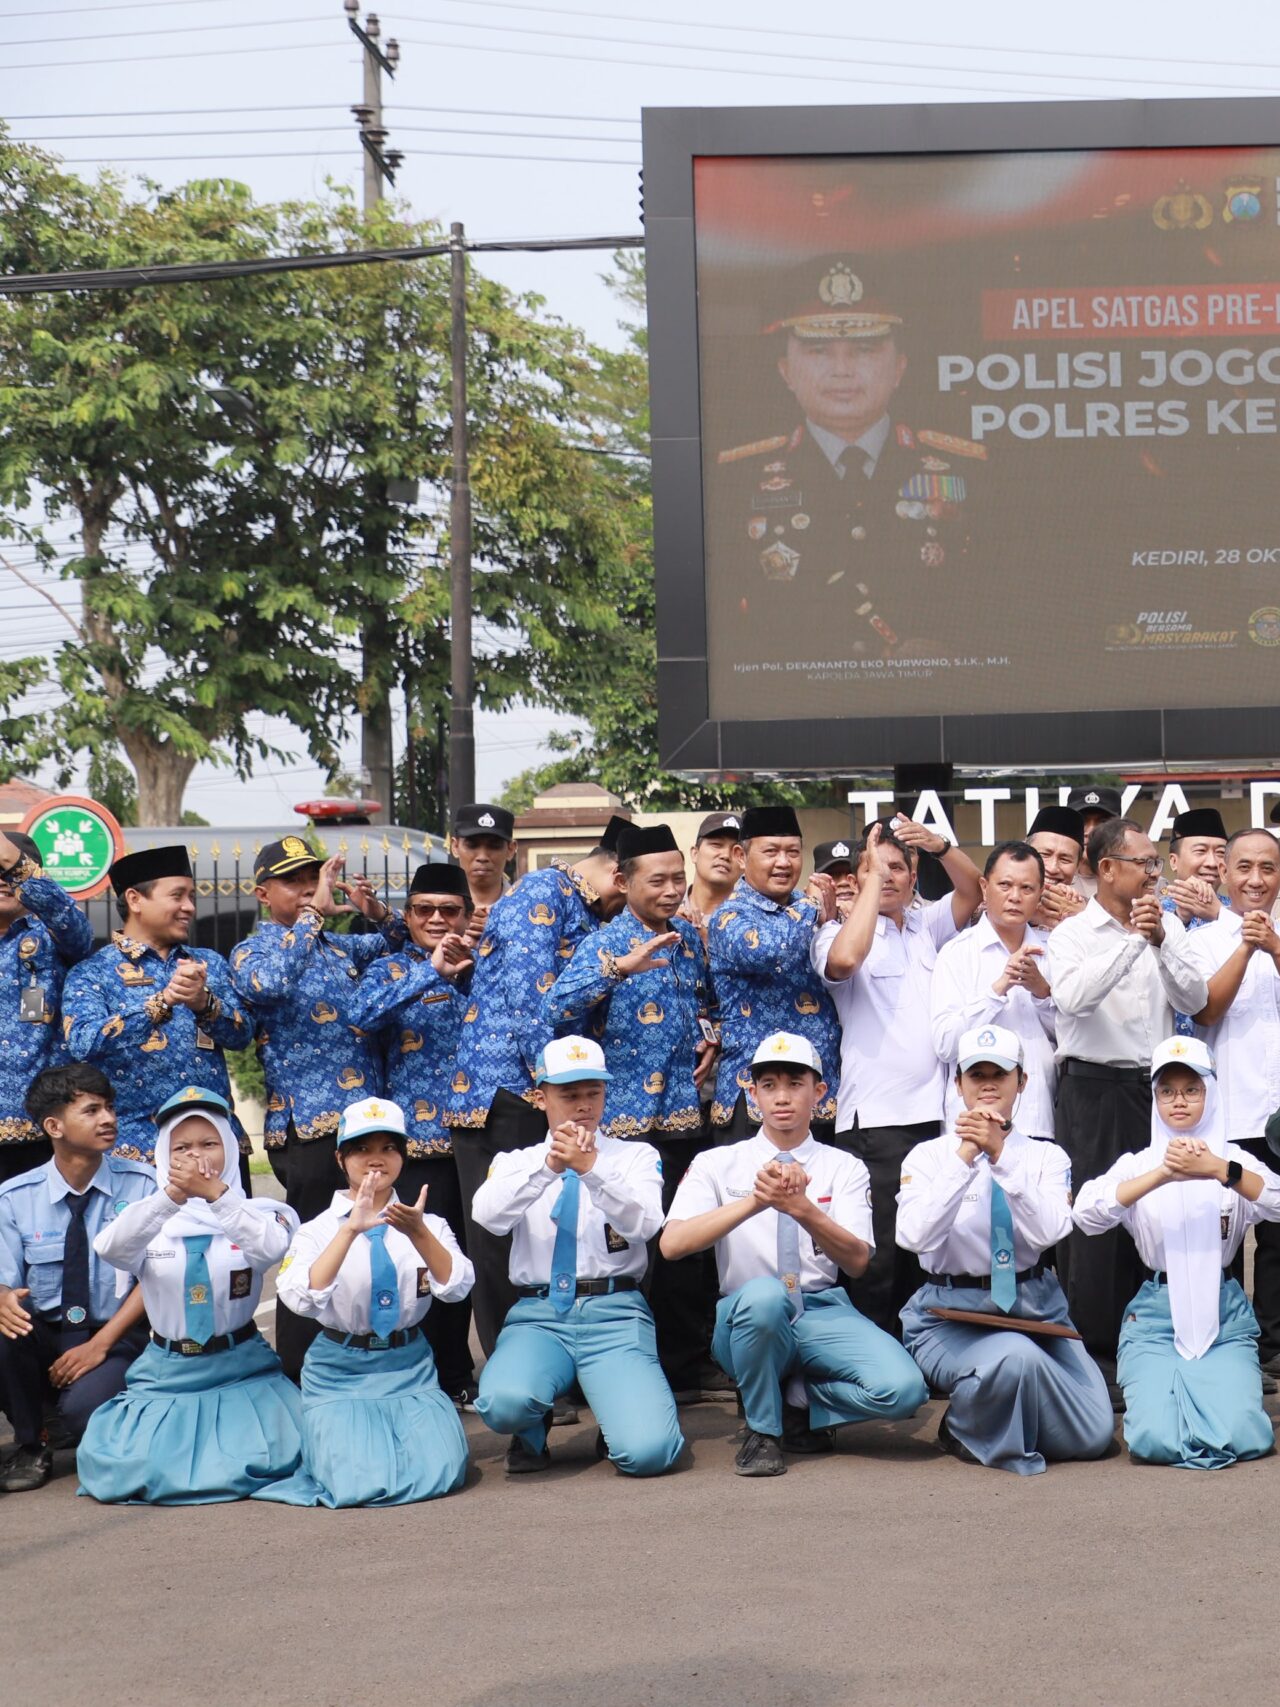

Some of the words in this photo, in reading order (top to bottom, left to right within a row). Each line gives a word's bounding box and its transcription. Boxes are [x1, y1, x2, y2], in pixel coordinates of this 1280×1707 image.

[1012, 297, 1084, 330] APEL
[1091, 294, 1199, 329] SATGAS
[937, 350, 1122, 392] POLISI
[971, 399, 1190, 440] POLRES
[1131, 550, 1208, 567] KEDIRI,
[1214, 549, 1241, 564] 28
[1136, 611, 1188, 625] POLISI
[1146, 623, 1193, 632] BERSAMA
[1141, 630, 1239, 644] MASYARAKAT
[786, 660, 858, 671] DEKANANTO
[861, 659, 884, 669] EKO
[887, 658, 951, 668] PURWONO,
[864, 670, 895, 679] JAWA
[898, 669, 934, 678] TIMUR
